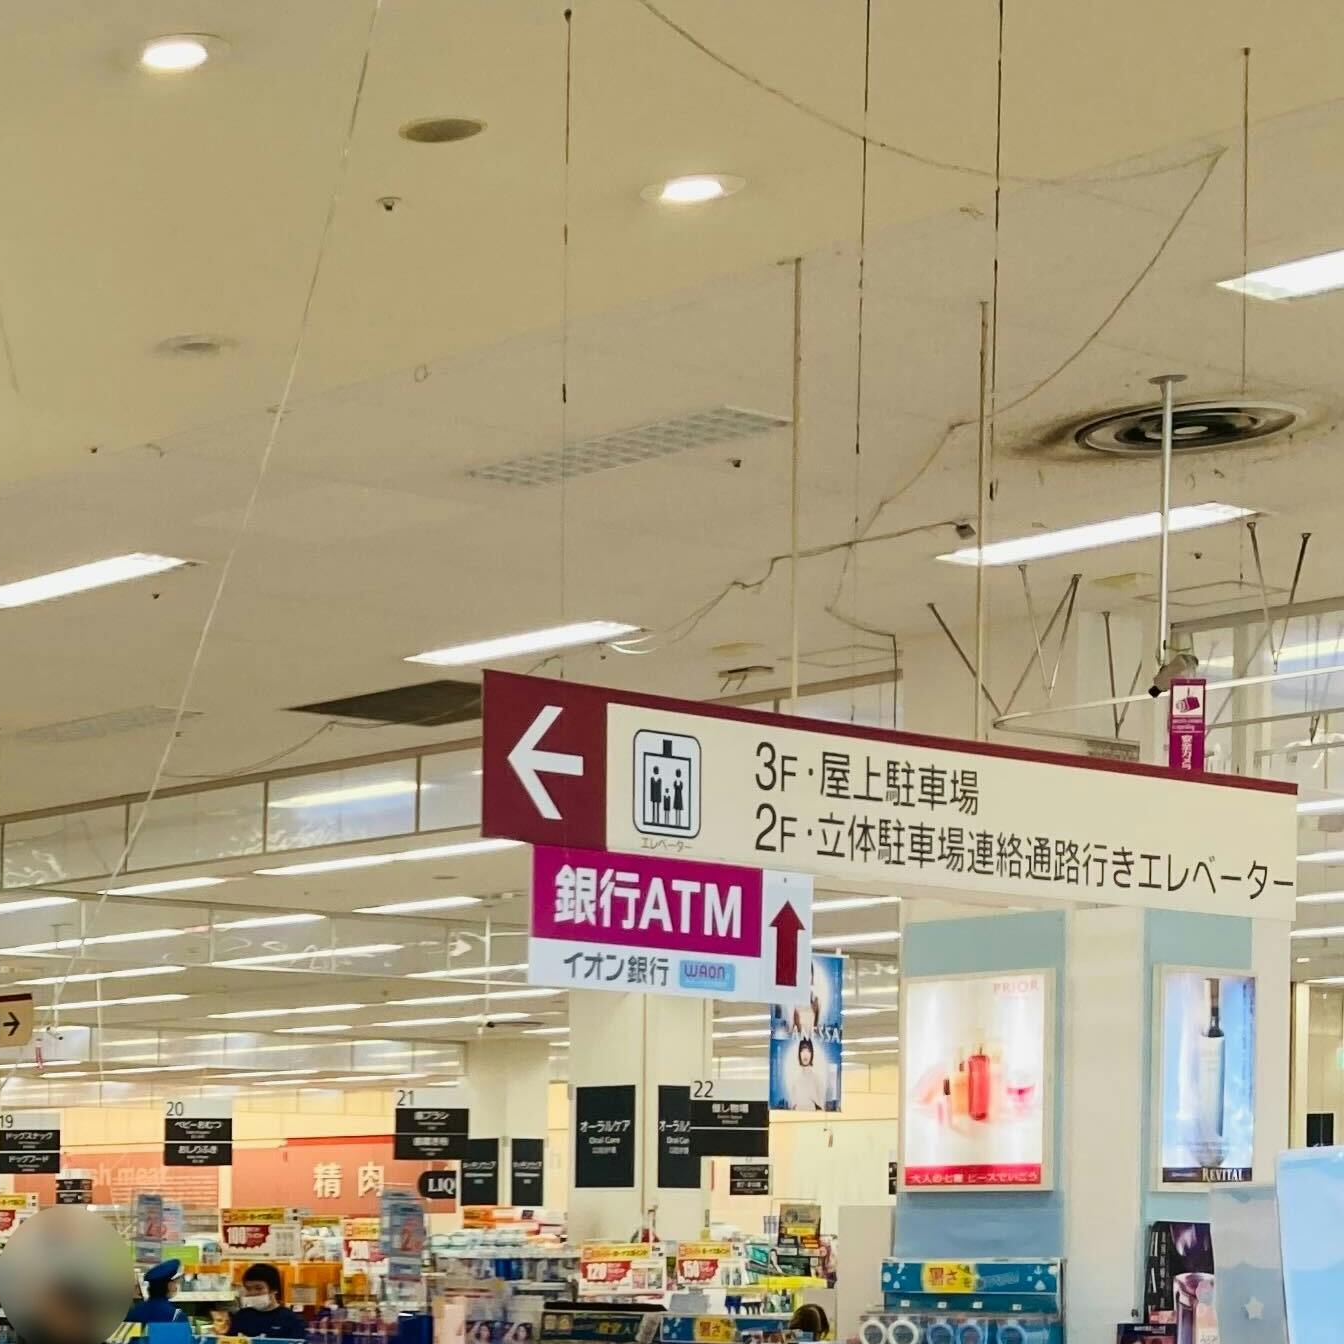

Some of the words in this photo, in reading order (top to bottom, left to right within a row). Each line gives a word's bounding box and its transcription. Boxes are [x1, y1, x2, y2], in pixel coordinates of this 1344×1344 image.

[755, 742, 979, 817] 3F・屋上駐車場
[555, 866, 743, 941] 銀行ATM
[563, 951, 669, 987] イオン銀行
[993, 980, 1039, 993] PRIOR
[694, 1080, 713, 1098] 22
[397, 1090, 414, 1106] 21
[166, 1102, 184, 1116] 20
[0, 1115, 13, 1128] 19
[580, 1120, 631, 1133] オーラルケア
[1202, 1168, 1243, 1181] REVITAL
